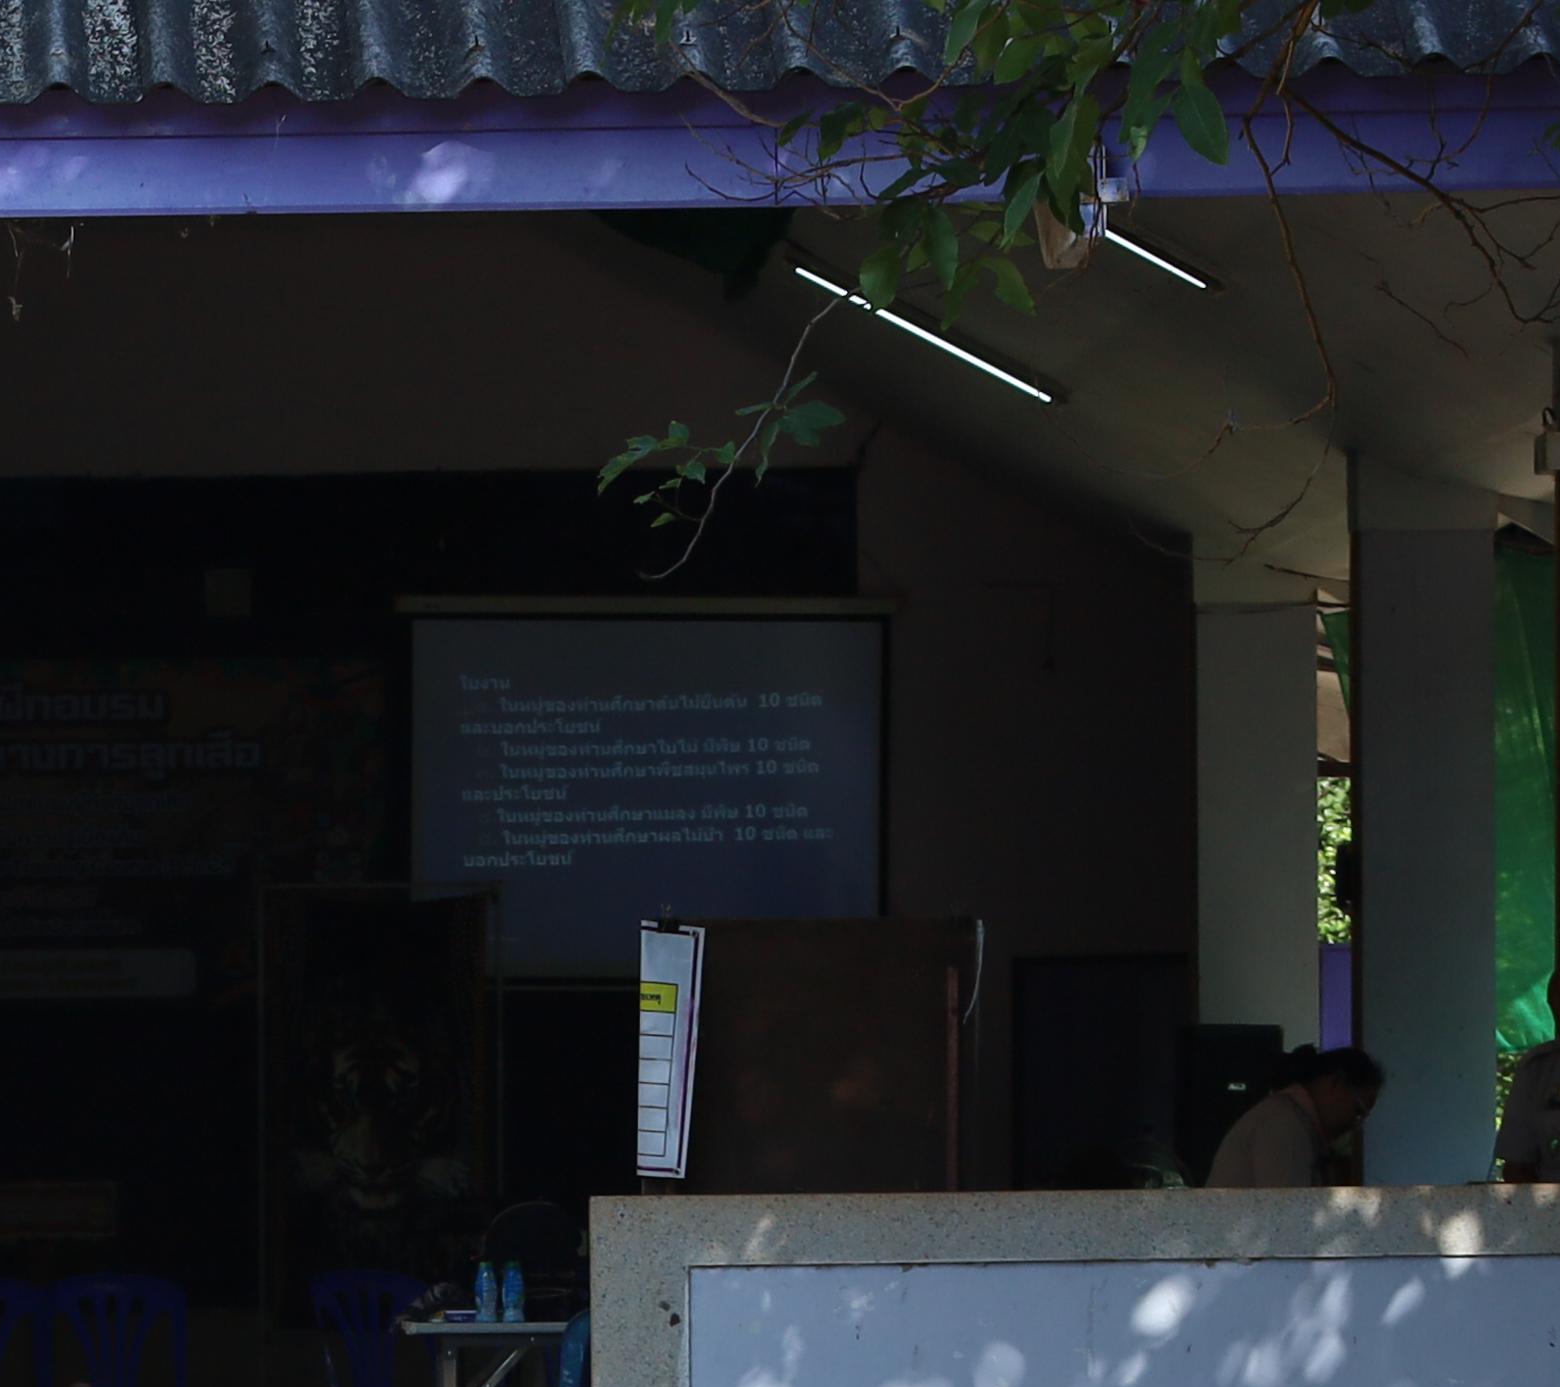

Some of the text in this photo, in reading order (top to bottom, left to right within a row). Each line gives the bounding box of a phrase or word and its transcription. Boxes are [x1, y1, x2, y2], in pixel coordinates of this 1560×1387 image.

[759, 692, 780, 708] 10
[785, 691, 823, 708] ชนิด
[748, 737, 768, 753] 10
[774, 736, 811, 752] ชนิด
[757, 759, 777, 775] 10
[783, 758, 820, 775] ชนิด
[745, 802, 766, 819] 10
[772, 802, 809, 819] ชนิด
[736, 826, 756, 841] 10
[761, 825, 798, 841] ชนิด
